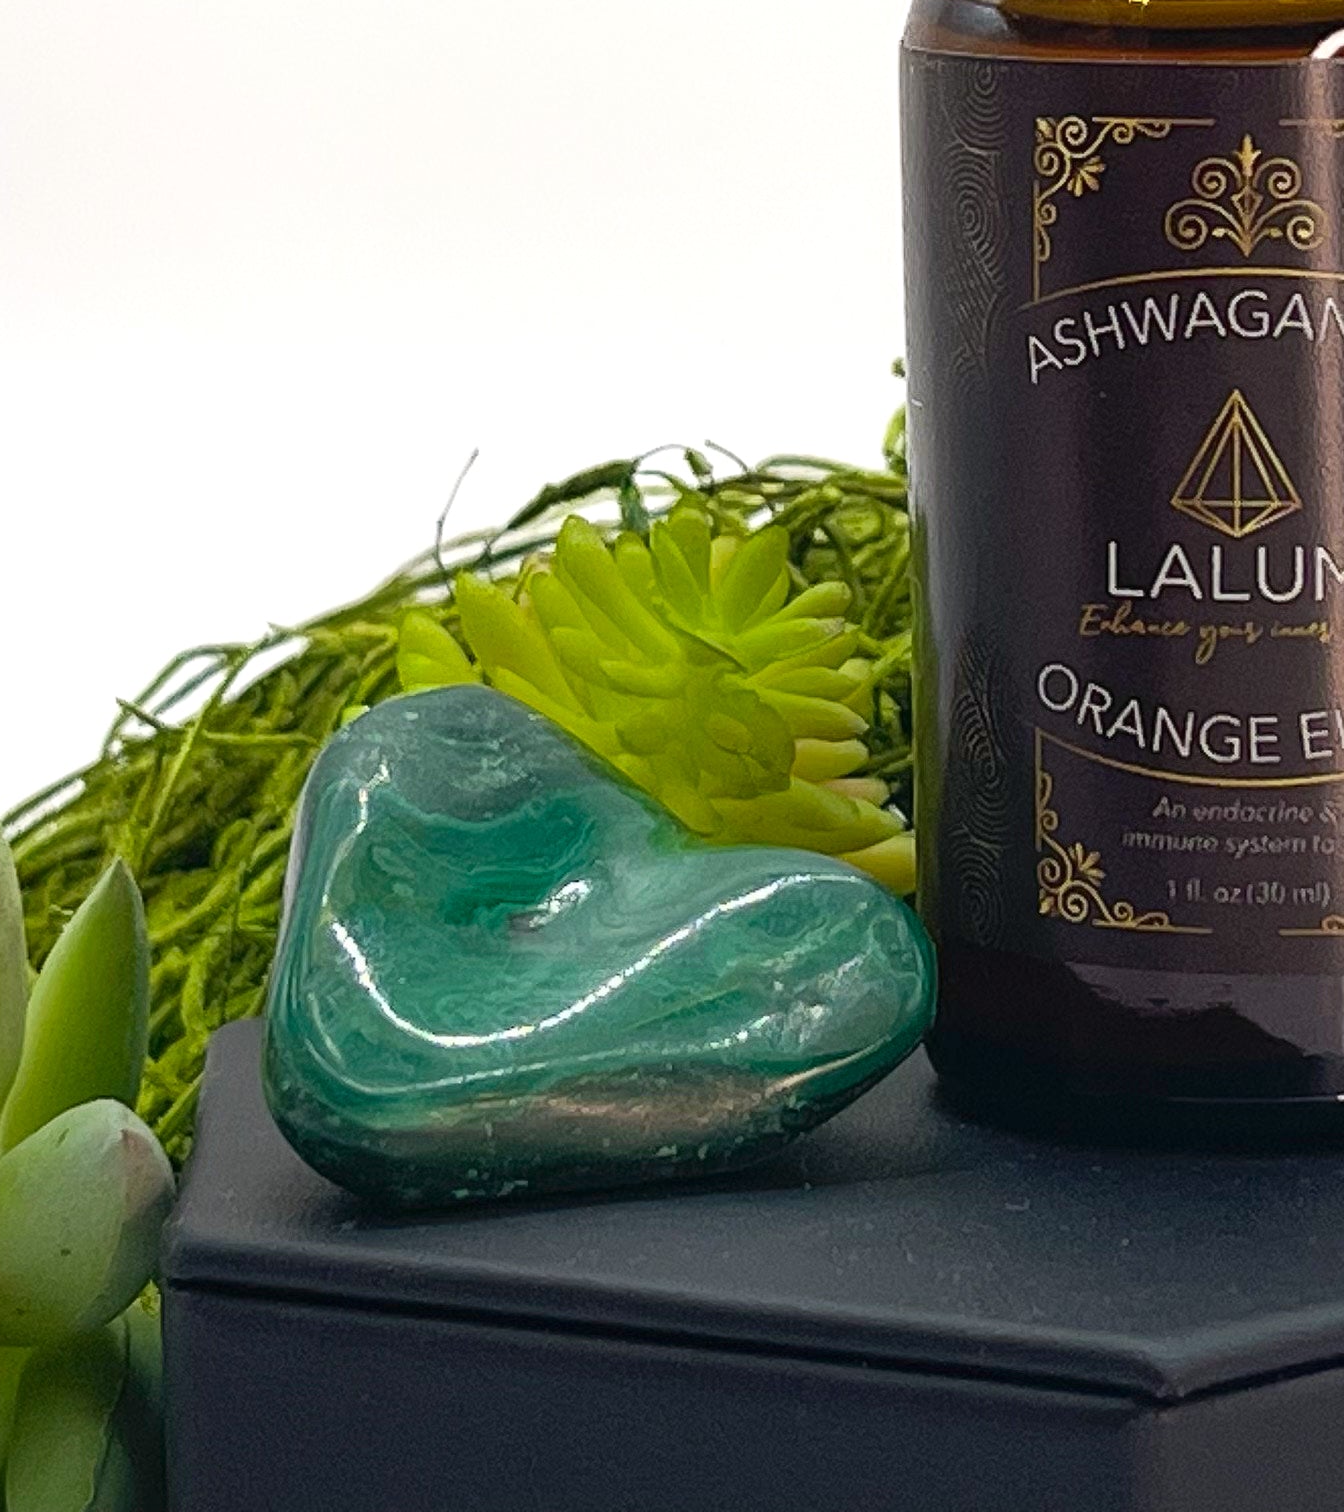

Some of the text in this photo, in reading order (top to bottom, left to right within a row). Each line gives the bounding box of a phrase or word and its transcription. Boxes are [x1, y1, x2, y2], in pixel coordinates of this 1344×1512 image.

[1079, 601, 1191, 638] Enhance
[1194, 624, 1265, 664] your
[1037, 663, 1282, 763] ORANGE
[1152, 795, 1187, 820] An
[1192, 798, 1313, 823] endocrine
[1122, 830, 1218, 853] immune
[1225, 834, 1307, 860] system
[1168, 879, 1177, 900] 1
[1213, 886, 1242, 903] oz
[1292, 881, 1332, 908] ml)
